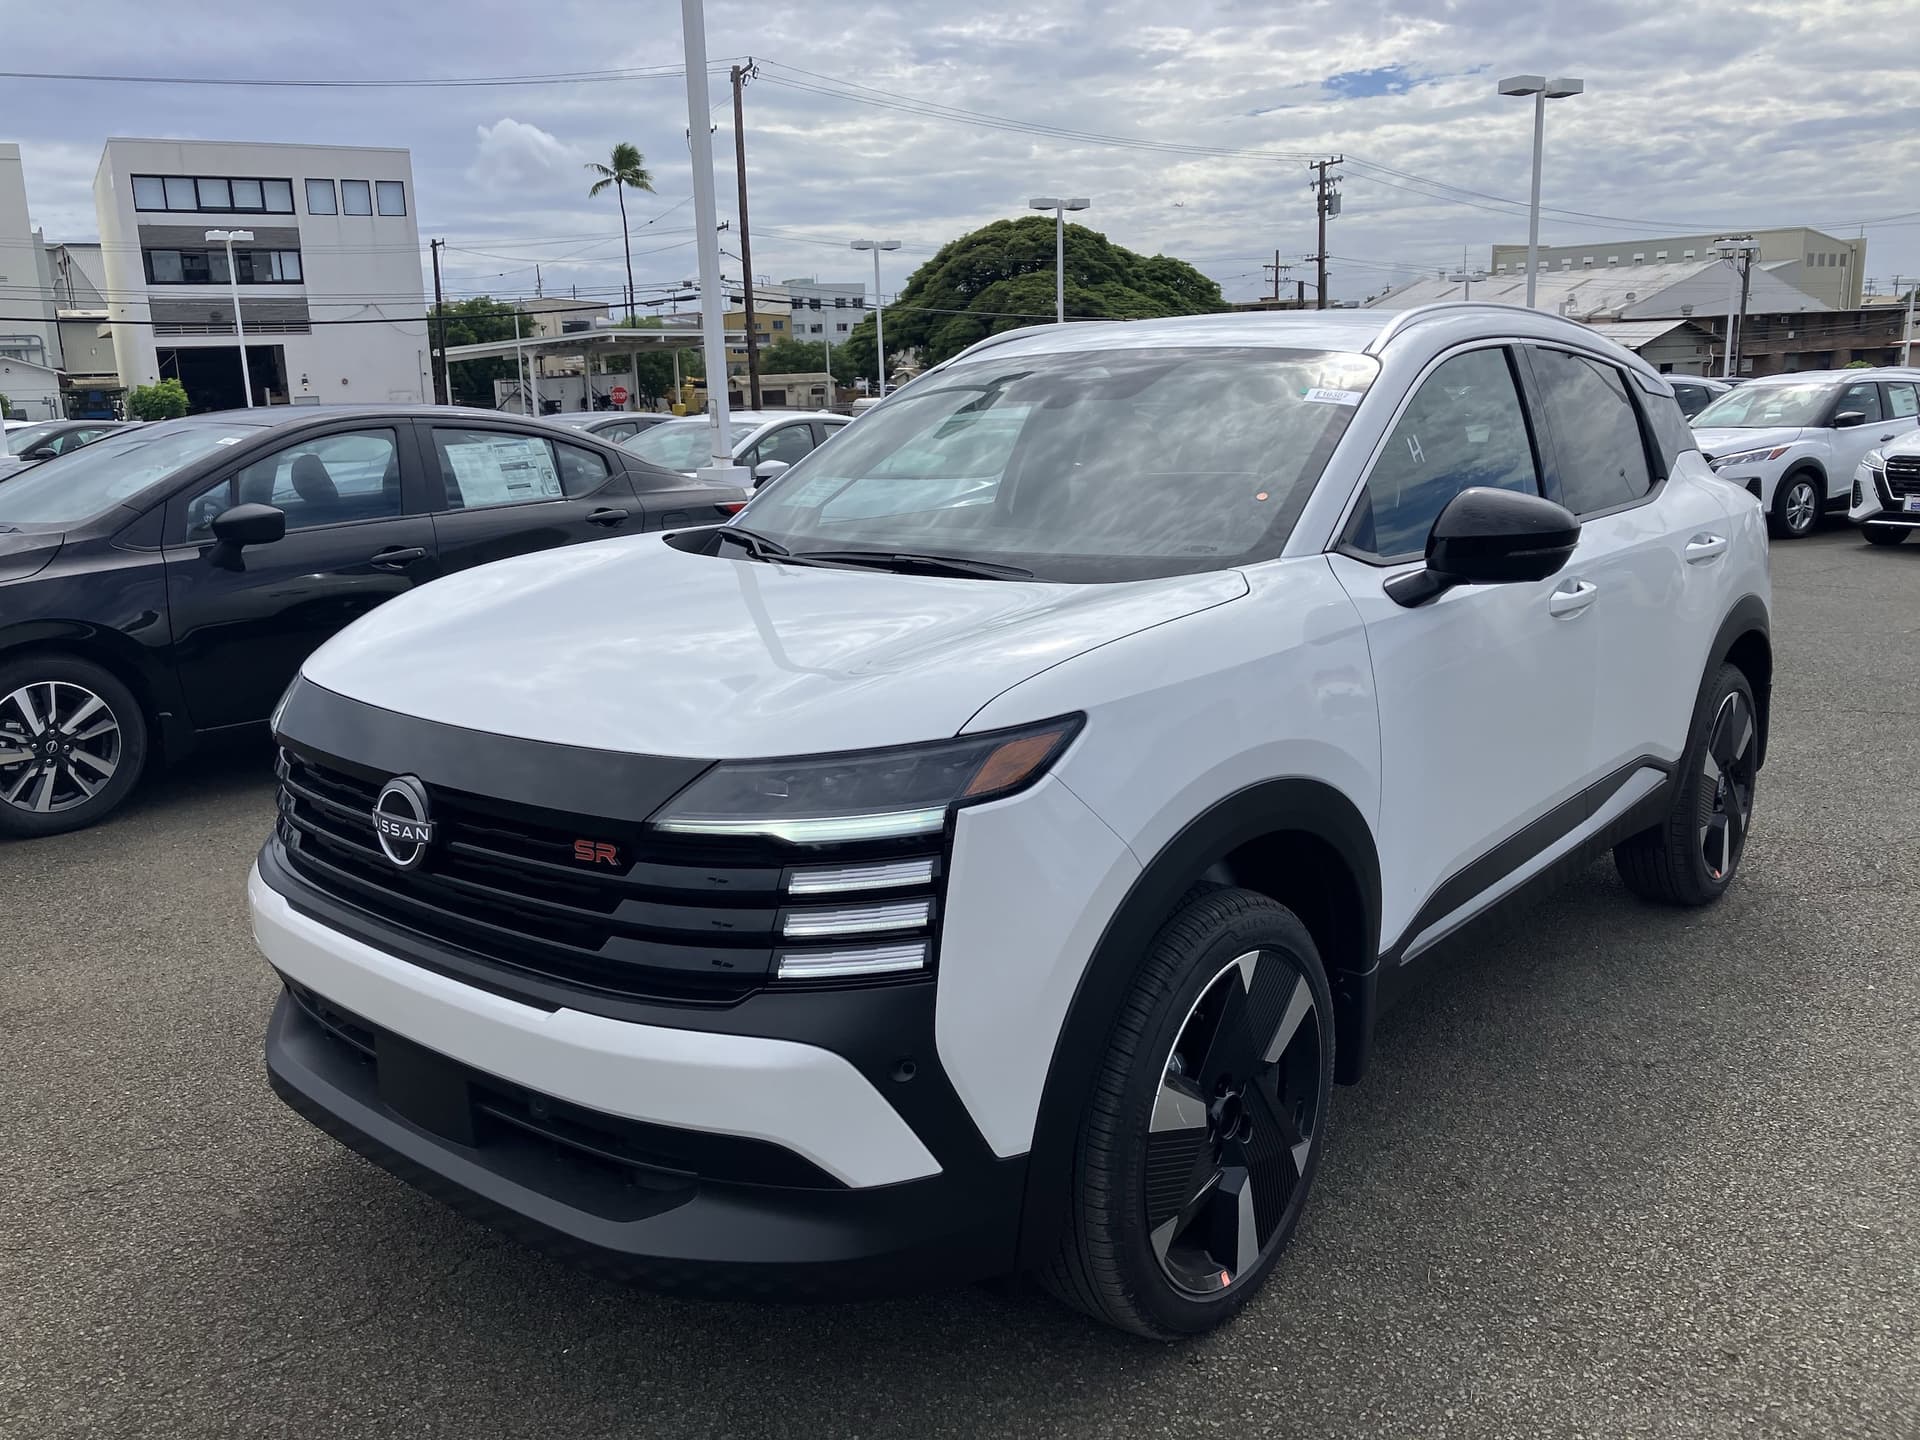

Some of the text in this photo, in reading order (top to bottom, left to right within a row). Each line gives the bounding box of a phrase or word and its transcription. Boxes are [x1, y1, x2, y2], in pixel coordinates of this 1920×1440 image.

[612, 392, 627, 400] STOP
[372, 811, 429, 841] NISSAN
[574, 839, 617, 866] SR
